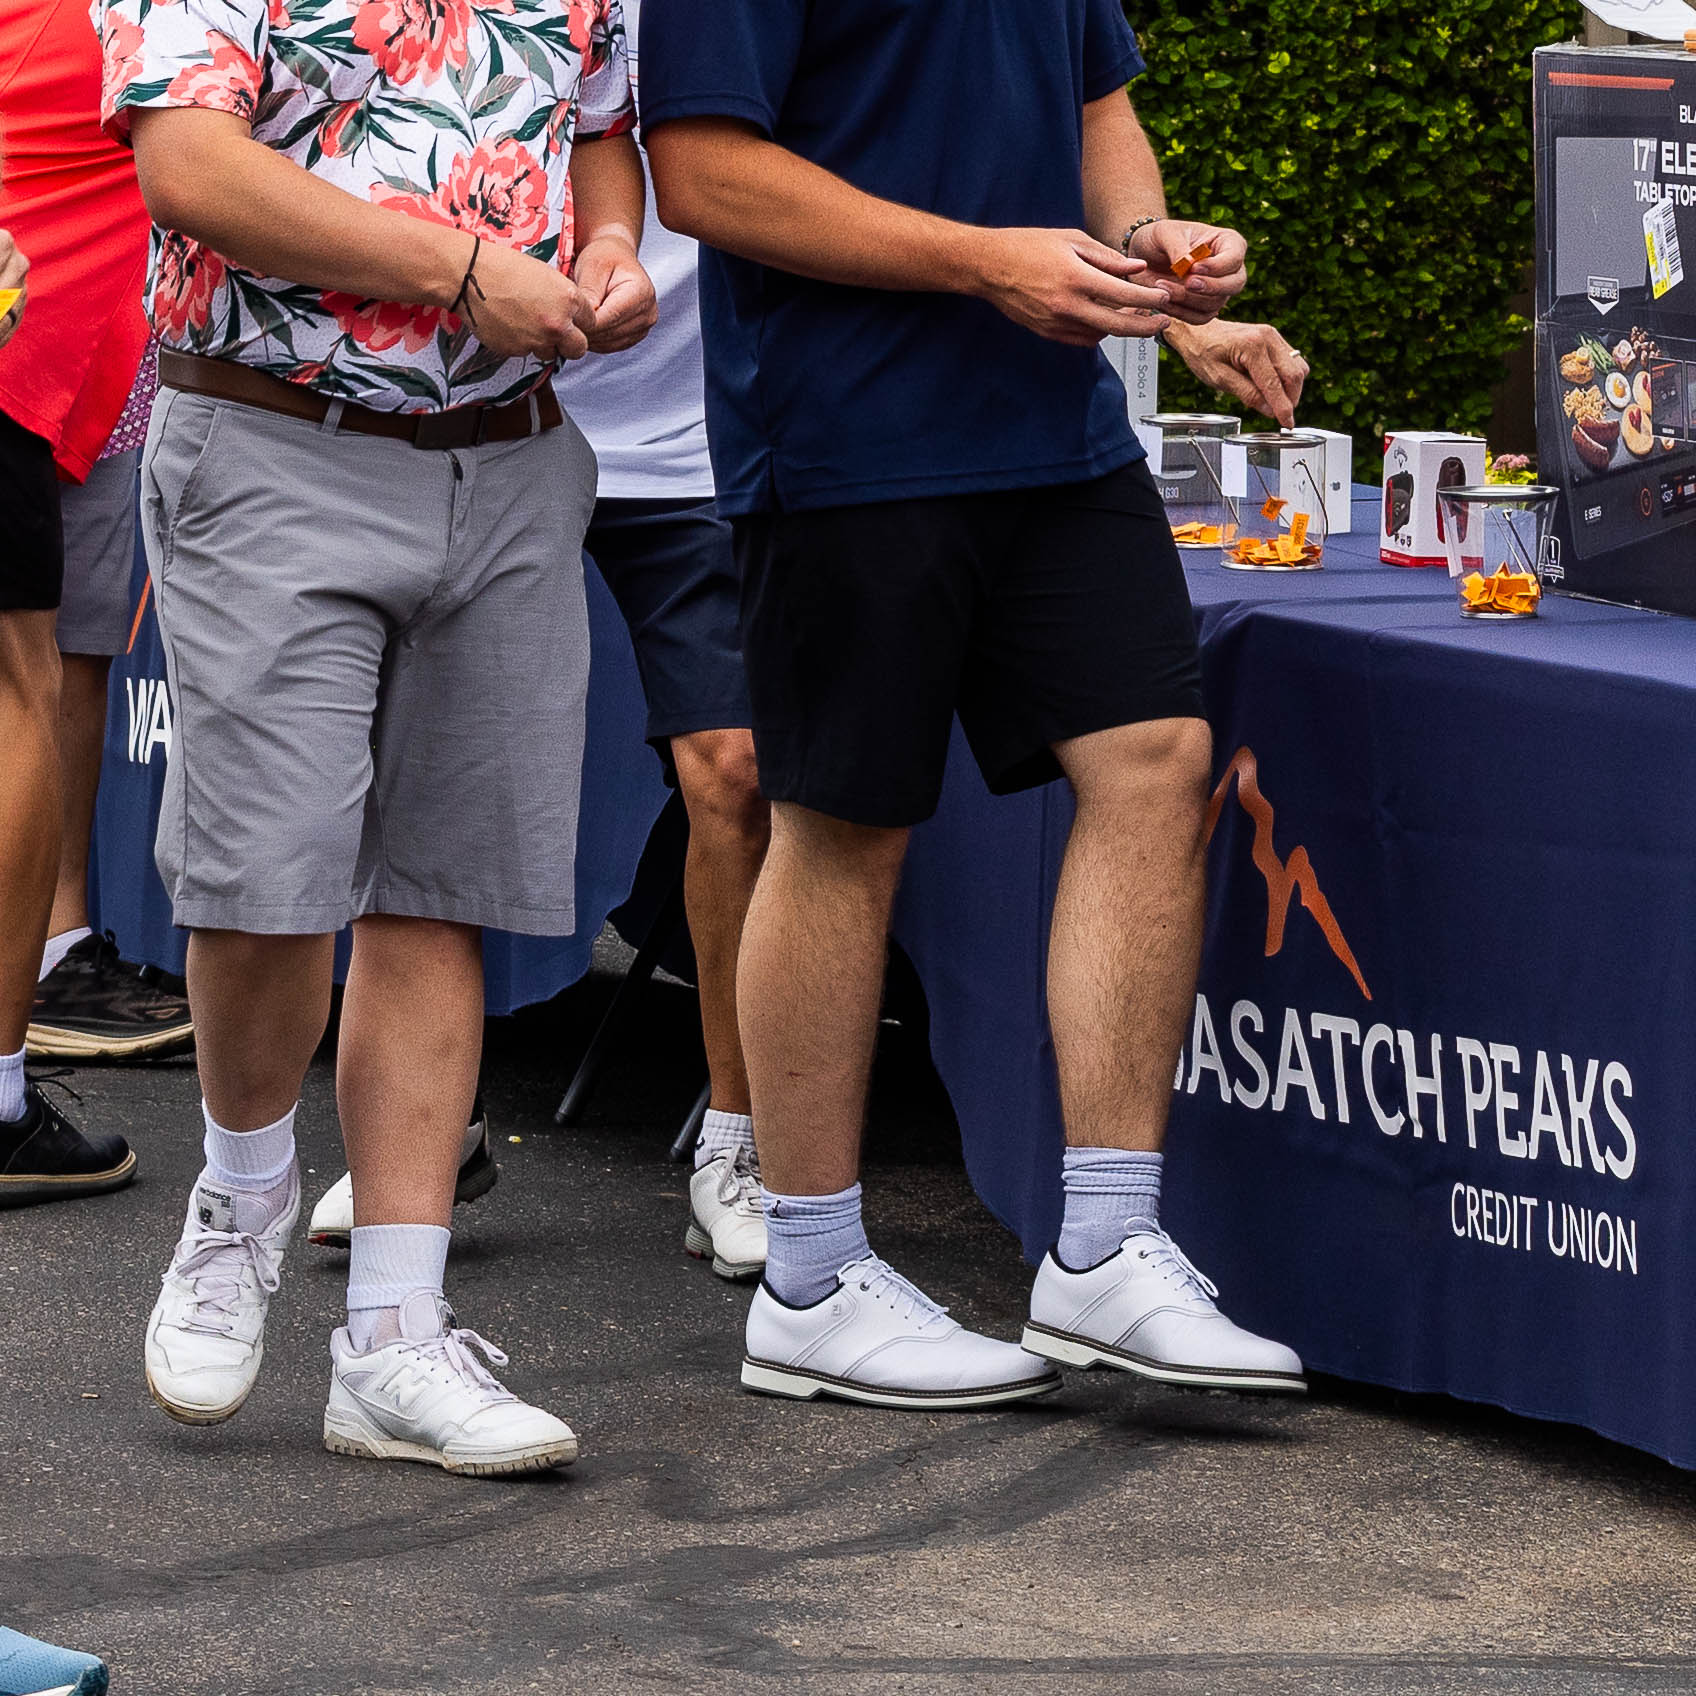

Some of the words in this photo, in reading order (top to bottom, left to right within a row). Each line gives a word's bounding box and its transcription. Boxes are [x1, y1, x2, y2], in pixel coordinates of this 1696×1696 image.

[1137, 364, 1148, 390] Solo
[1455, 1036, 1638, 1180] PEAKS
[1451, 1182, 1539, 1253] CREDIT
[1547, 1198, 1638, 1275] UNION
